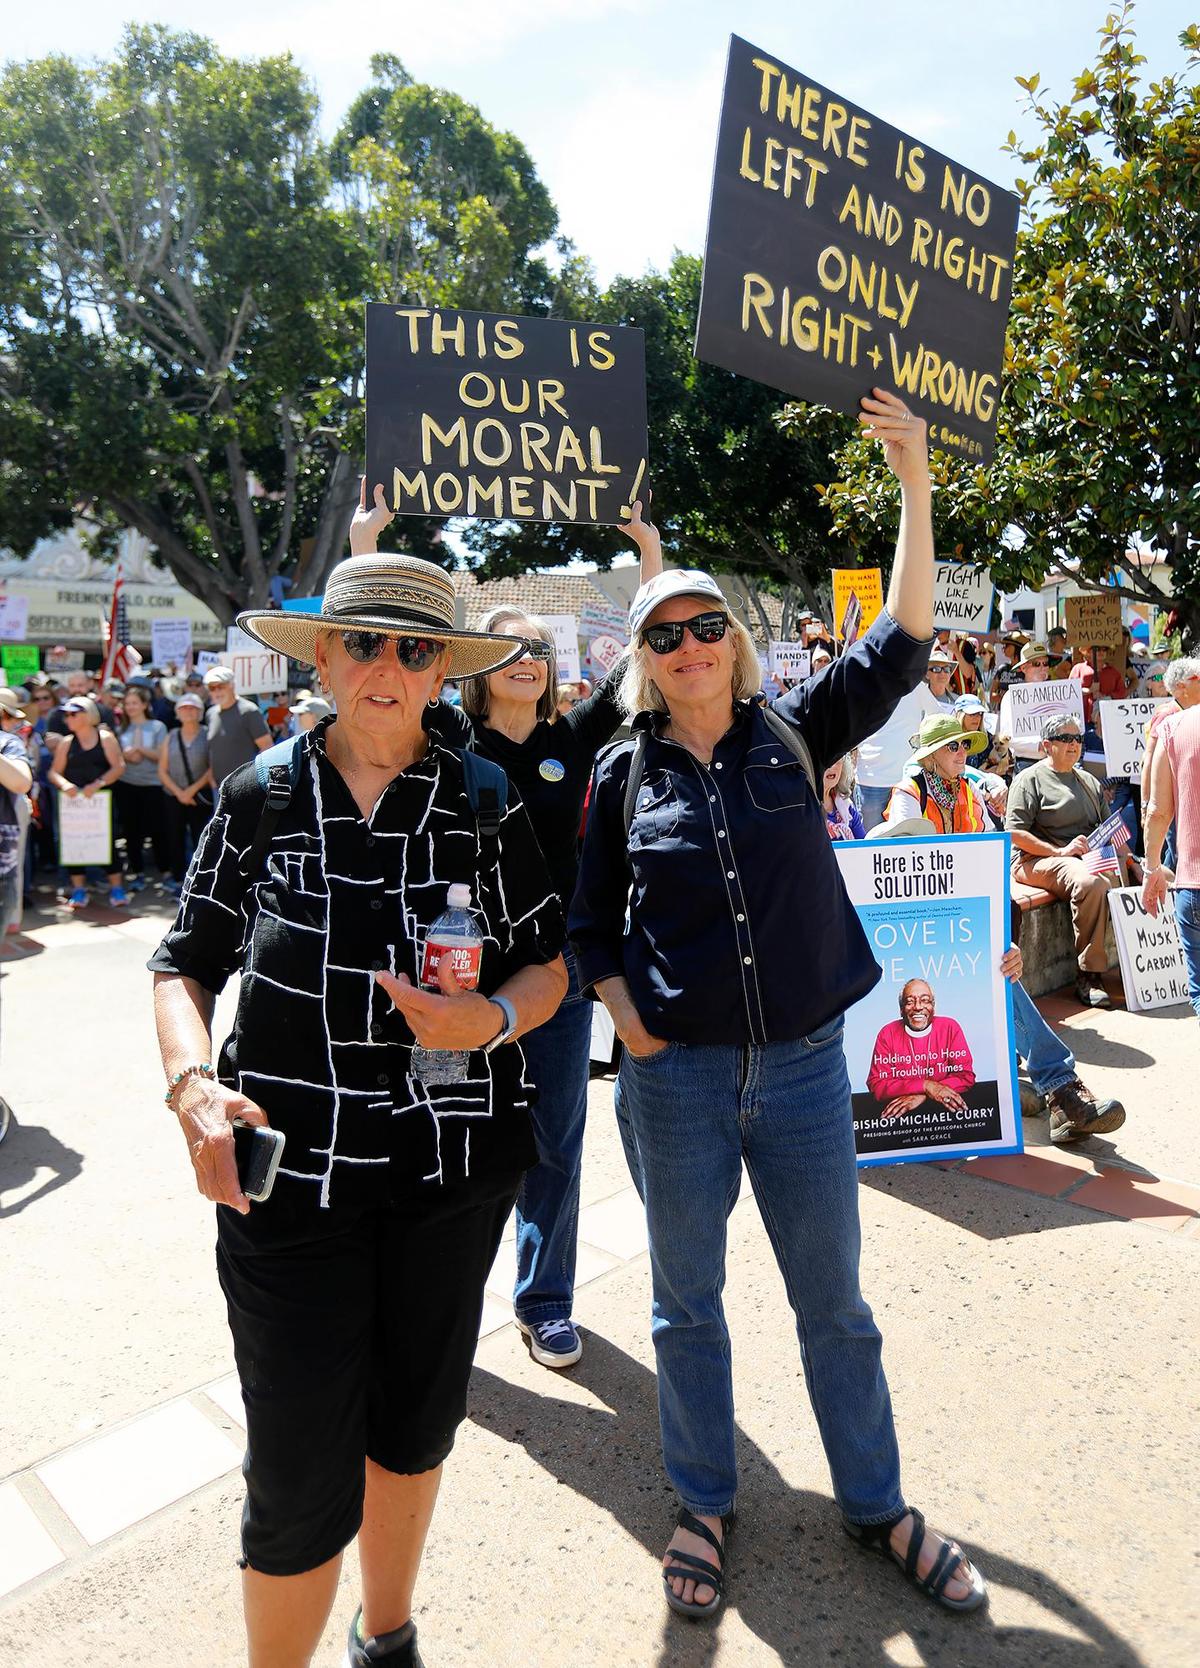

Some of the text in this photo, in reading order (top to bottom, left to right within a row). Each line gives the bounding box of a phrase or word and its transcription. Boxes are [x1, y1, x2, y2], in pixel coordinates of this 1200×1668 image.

[752, 57, 991, 227] THERE IS NO
[740, 127, 1010, 302] LEFT AND RIGHT
[817, 245, 919, 329] ONLY
[395, 309, 616, 371] THIS IS
[741, 272, 873, 368] RIGHT
[889, 333, 998, 423] WRONG
[459, 371, 570, 420] OUR
[421, 412, 622, 474] MORAL
[936, 565, 982, 588] FIGHT
[57, 591, 175, 608] FREMONLO.COM
[946, 587, 969, 599] LIKE
[1070, 597, 1096, 606] WHO
[29, 615, 73, 630] OFFICE
[1071, 618, 1103, 628] VOTED
[1078, 628, 1119, 641] MUSK?
[1012, 683, 1079, 705] PRO-AMERICA
[1117, 703, 1155, 716] STOP
[873, 849, 954, 875] Here is the
[874, 872, 954, 899] SOLUTION!
[874, 917, 973, 949] OVE IS
[918, 951, 983, 979] WAY
[1136, 954, 1177, 973] CARBON
[1140, 979, 1189, 1003] is to HIG
[874, 1047, 967, 1065] Holding on to Hope
[879, 1062, 964, 1079] in Troubling Times
[853, 1107, 994, 1131] BISHOP MICHAEL CURRY
[863, 1130, 892, 1138] PRESIDING
[893, 1128, 913, 1136] BISHOP
[964, 1121, 986, 1129] CHURCH
[912, 1135, 928, 1143] SARA
[930, 1133, 951, 1141] GRACE
